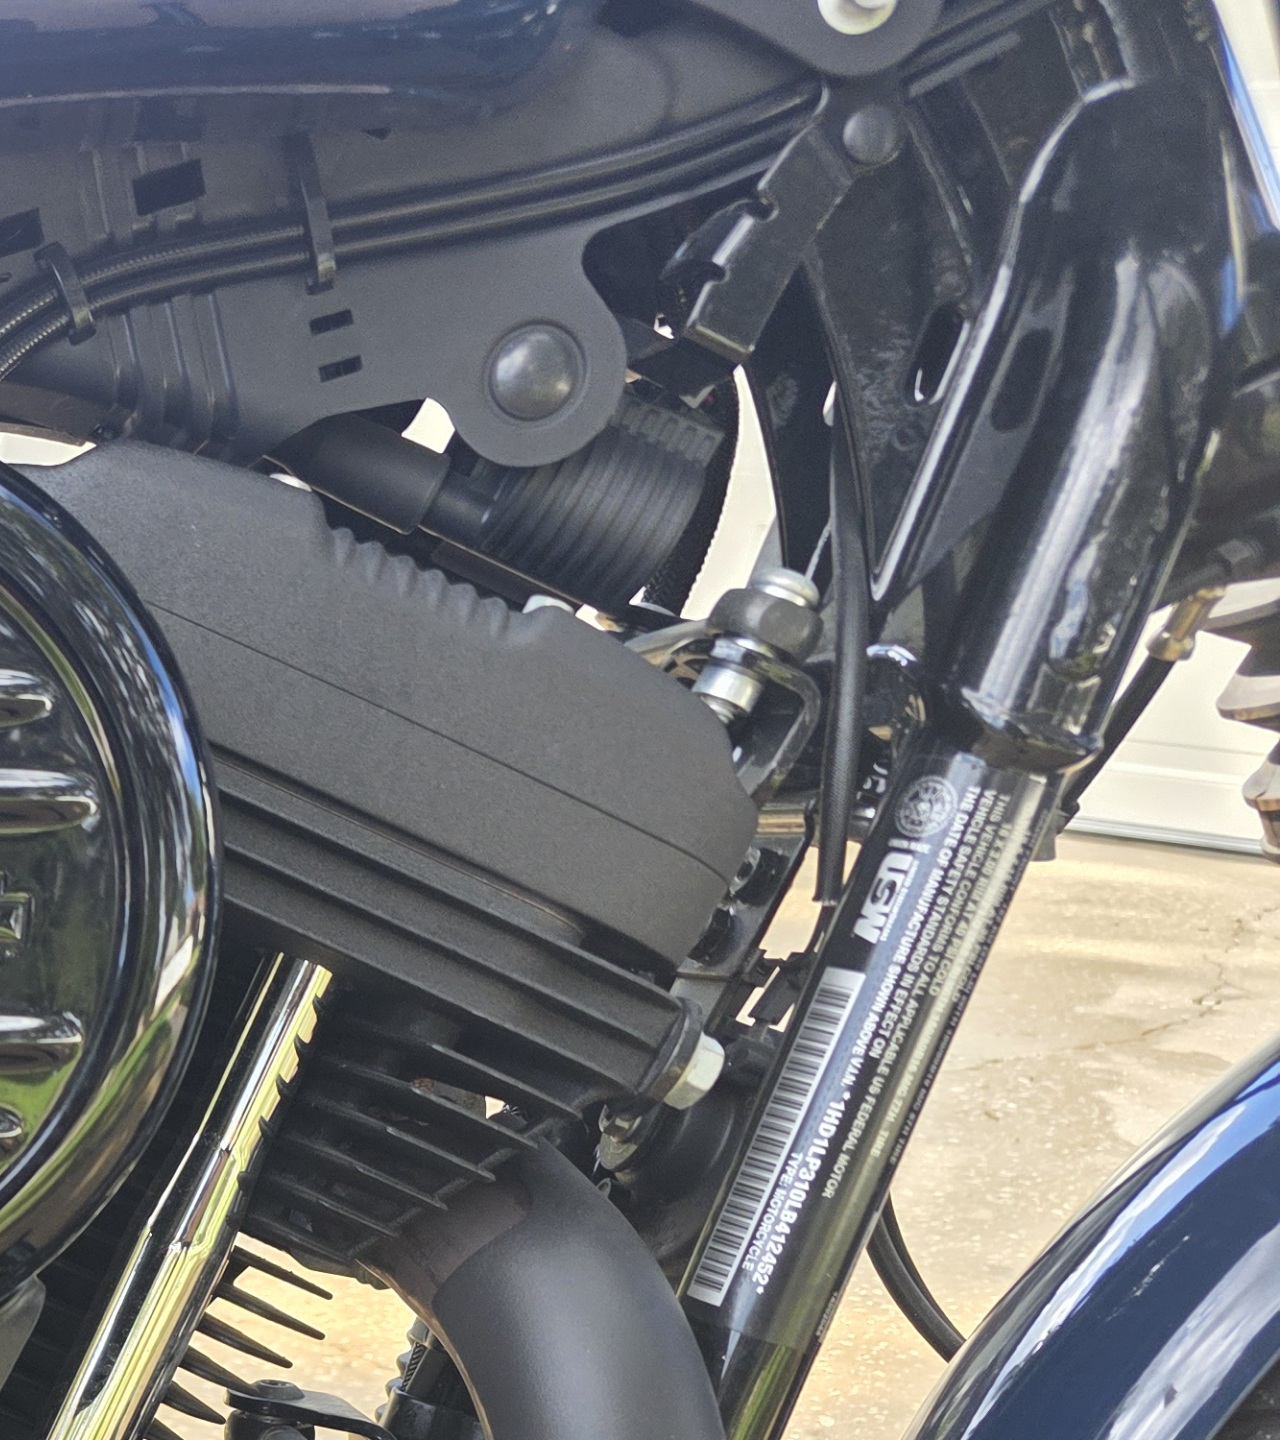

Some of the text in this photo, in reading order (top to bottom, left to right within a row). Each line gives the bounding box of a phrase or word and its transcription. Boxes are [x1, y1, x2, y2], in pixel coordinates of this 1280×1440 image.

[958, 786, 981, 810] THE
[963, 789, 998, 842] VEHICLE
[988, 794, 1011, 821] THIS
[942, 813, 969, 846] DATE
[963, 826, 997, 877] VEHICLE
[940, 846, 972, 893] SAFETY
[891, 869, 944, 962] MANUFACTURE
[905, 896, 950, 971] STANDARDS
[930, 880, 973, 951] CONFORMS
[869, 964, 902, 1011] SHOWN
[910, 974, 931, 996] ALL
[925, 960, 952, 994] COLD
[850, 1013, 881, 1054] ABOVE
[877, 989, 908, 1034] EFFECT
[876, 1000, 919, 1073] APPLICABLE
[841, 1097, 876, 1151] FEDERAL
[820, 1154, 850, 1197] MOTOR
[739, 1151, 803, 1269] TYPE: MOTORCYCLE
